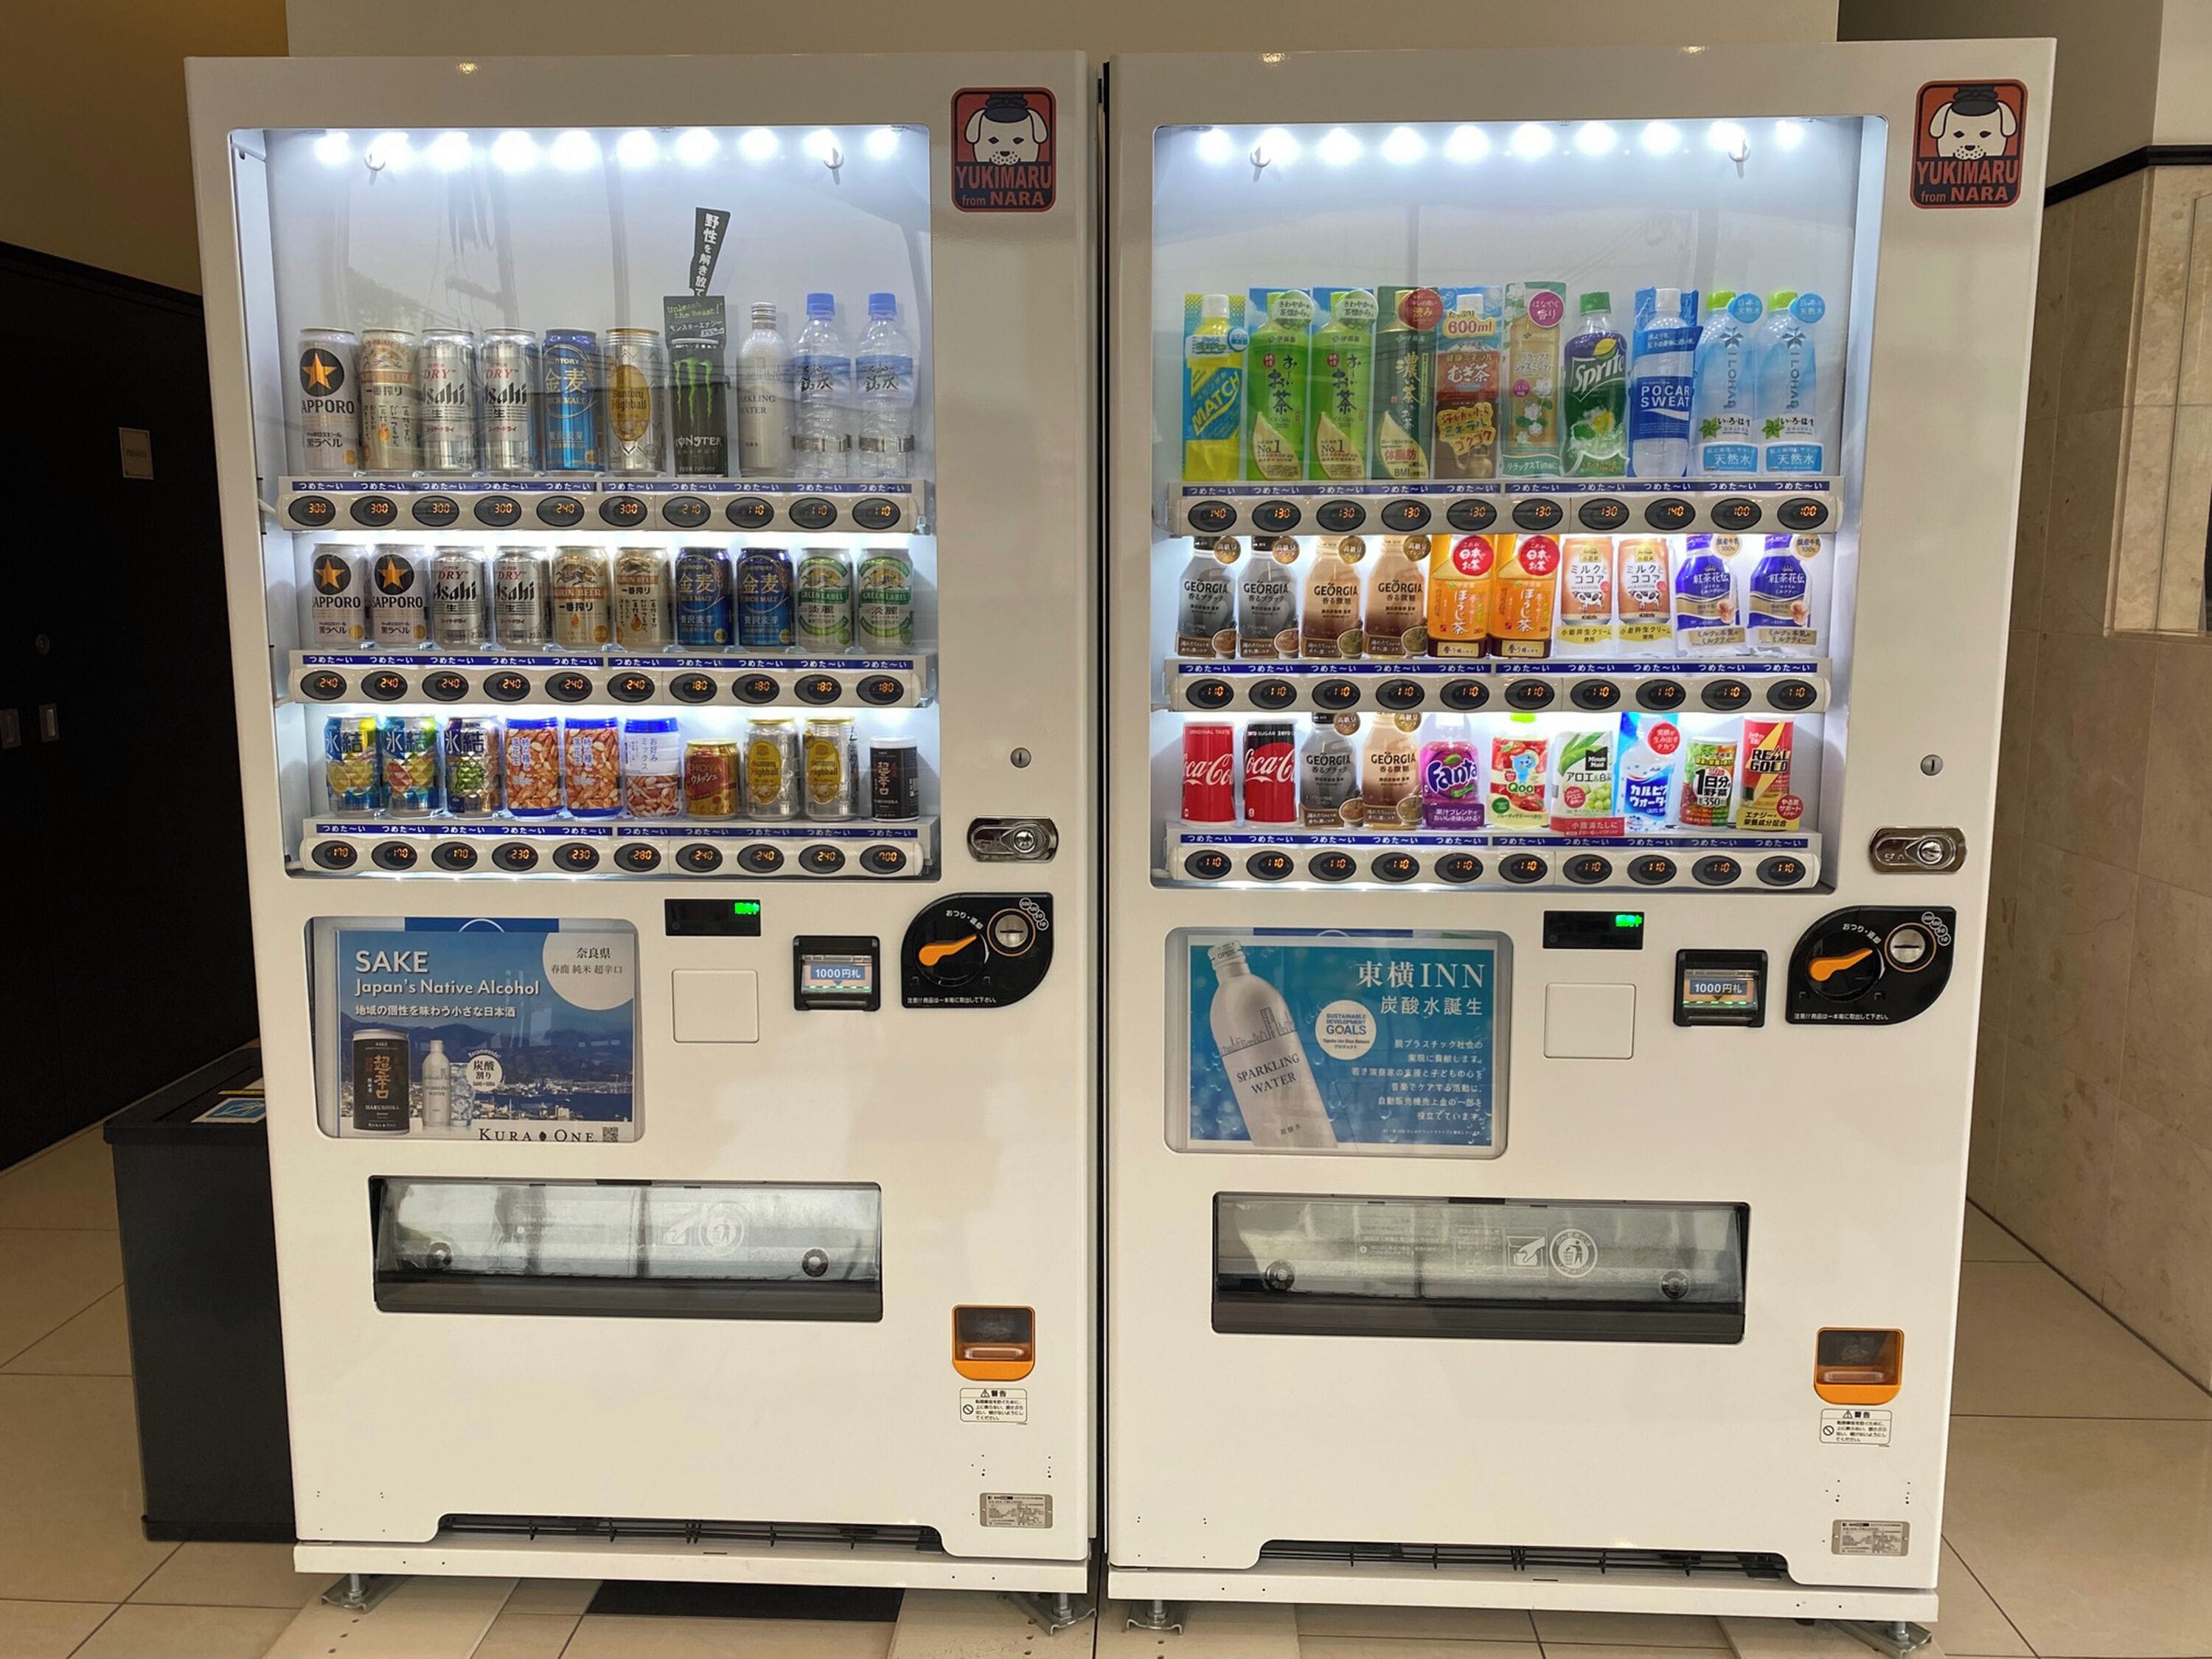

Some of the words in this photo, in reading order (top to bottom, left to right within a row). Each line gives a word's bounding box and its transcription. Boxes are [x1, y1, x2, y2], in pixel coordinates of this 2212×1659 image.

[956, 166, 1051, 189] YUKIMARU
[1917, 160, 2019, 184] YUKIMARU
[962, 195, 986, 206] from
[990, 191, 1044, 206] NARA
[1921, 191, 1946, 202] from
[1950, 187, 2008, 201] NARA
[1447, 320, 1492, 333] 600ml
[1447, 363, 1491, 383] むぎ茶
[544, 368, 588, 393] 金麦
[1641, 385, 1690, 397] POCAR
[302, 399, 355, 414] APPORO
[1192, 371, 1240, 431] MATCH
[1641, 397, 1690, 408] SWEAT
[1714, 453, 1751, 465] 天然水
[1778, 453, 1815, 465] 天然水
[309, 503, 326, 513] 300
[495, 503, 512, 513] 300
[621, 504, 639, 514] 300
[874, 506, 891, 515] 110
[1211, 508, 1226, 518] 140
[1404, 507, 1420, 519] 130
[1535, 505, 1551, 517] 130
[1801, 506, 1817, 516] 100
[678, 572, 714, 593] 金麦
[742, 572, 780, 594] 金麦
[1575, 575, 1604, 584] ココア
[1631, 575, 1660, 583] ココア
[1693, 572, 1729, 584] 紅茶花伝
[1768, 572, 1805, 584] 紅茶花伝
[1451, 590, 1469, 635] ほうじ茶
[1517, 589, 1534, 632] ほうじ茶
[319, 678, 338, 688] 240
[502, 679, 521, 689] 240
[627, 680, 645, 689] 240
[880, 682, 894, 692] 180
[1208, 686, 1224, 696] 110
[1398, 686, 1413, 696] 110
[1528, 686, 1543, 697] 110
[1790, 687, 1805, 697] 110
[1752, 748, 1790, 760] REAL
[1750, 760, 1788, 773] GOLD
[1508, 782, 1534, 793] Qoo
[1571, 821, 1618, 830] 小腹満たしに
[1743, 818, 1787, 827] 栄養成分配合
[333, 848, 348, 857] 170
[511, 849, 529, 859] 230
[633, 850, 652, 860] 280
[880, 852, 897, 862] 700
[1206, 858, 1222, 867] 110
[1394, 859, 1409, 869] 110
[1522, 861, 1537, 871] 110
[1778, 863, 1794, 873] 110
[576, 947, 611, 959] 奈良県
[355, 950, 428, 973] SAKE
[571, 964, 592, 974] 純米
[594, 964, 623, 974] 超辛口
[814, 968, 861, 980] 1000円札
[1356, 960, 1486, 989] 東横INN
[355, 978, 417, 997] Japan's
[420, 979, 473, 995] Native
[477, 979, 540, 995] Alcohol
[1694, 982, 1742, 994] 1000円札
[1380, 995, 1484, 1016] 炭酸水誕生
[355, 1005, 517, 1018] 地域の個性を味わう小さな日本酒
[1326, 1025, 1367, 1035] GOALS
[1394, 1039, 1484, 1049] 脱プラスチック社会の
[473, 1060, 495, 1071] 炭酸
[1236, 1054, 1300, 1082] SPARKLING
[476, 1072, 492, 1080] 割り
[1251, 1072, 1297, 1094] WATER
[479, 1128, 531, 1141] KURA
[554, 1129, 594, 1143] ONE
